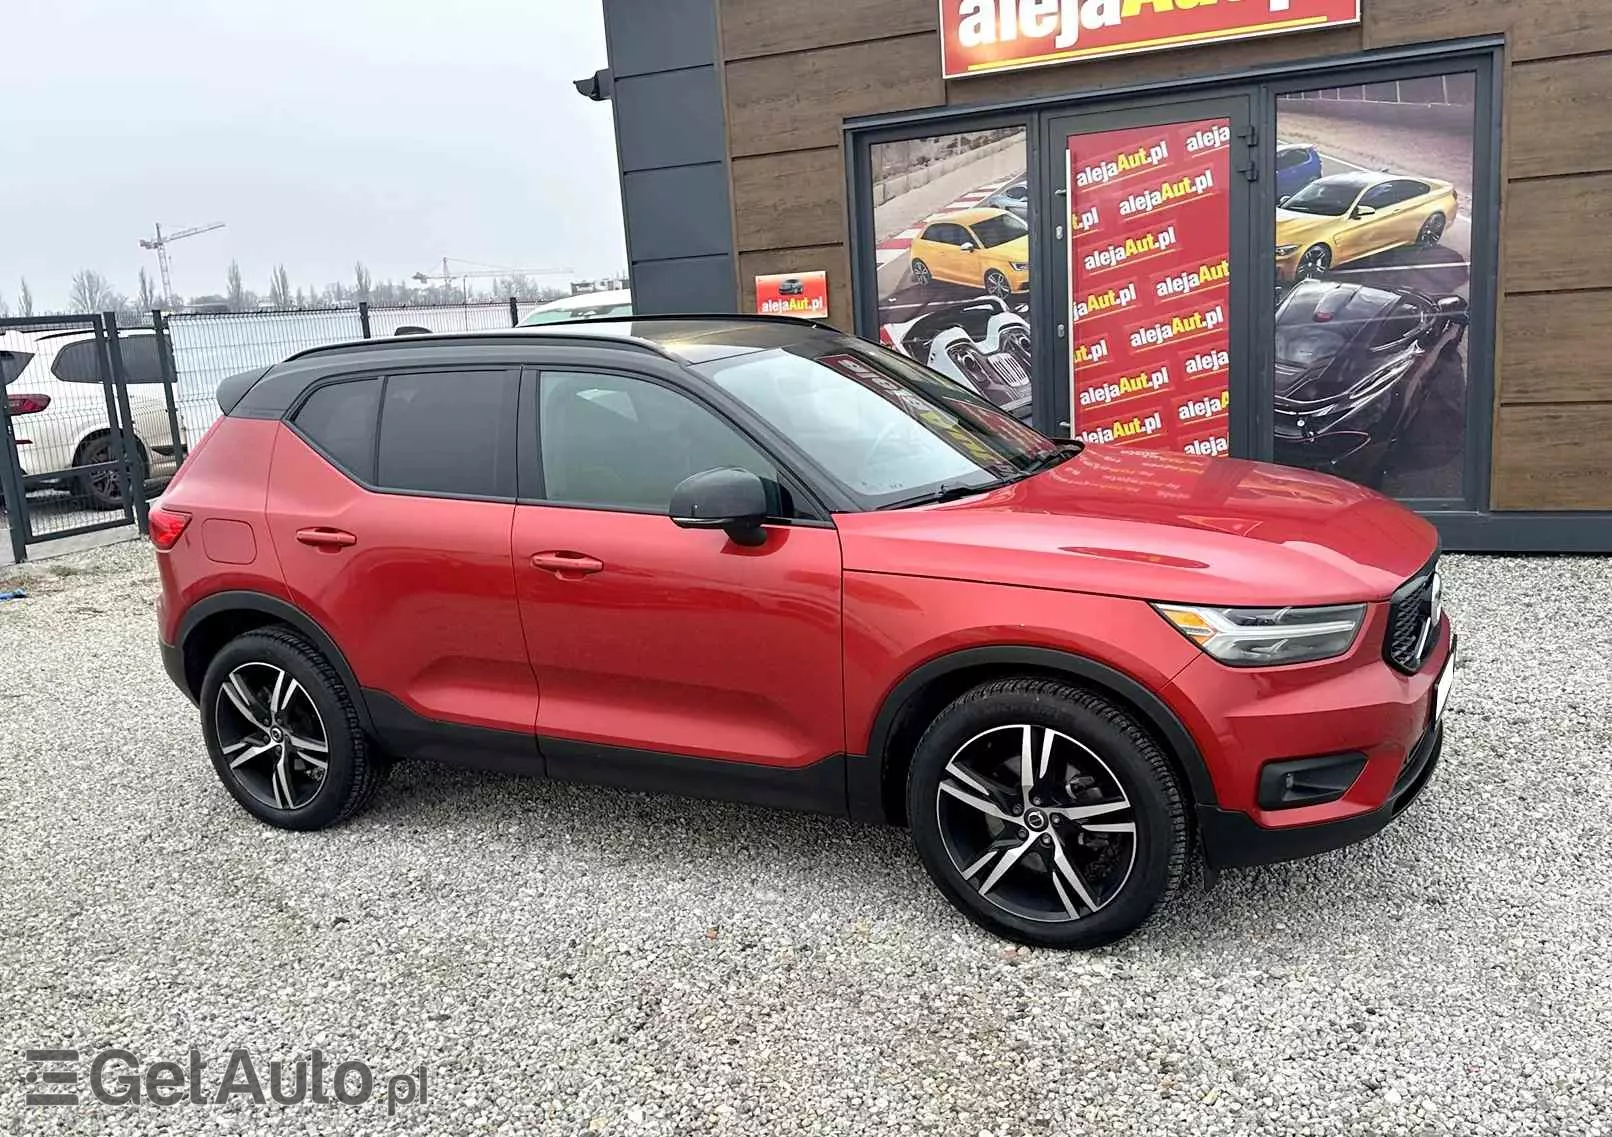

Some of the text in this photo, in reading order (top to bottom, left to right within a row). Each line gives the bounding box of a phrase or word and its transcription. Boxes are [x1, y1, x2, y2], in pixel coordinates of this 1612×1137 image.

[1186, 125, 1230, 152] aleja
[1076, 140, 1168, 187] alejaAut.pl
[1119, 170, 1214, 216] alejaAut.pl
[1083, 226, 1176, 270] alejaAut.pl
[1156, 260, 1229, 297] alejaAut
[762, 296, 823, 313] alejaAut.pl
[1130, 306, 1224, 348] alejaAut.pl
[1185, 349, 1229, 374] aleja
[1079, 367, 1169, 406] alejaAut.pl
[1184, 436, 1228, 457] aleja
